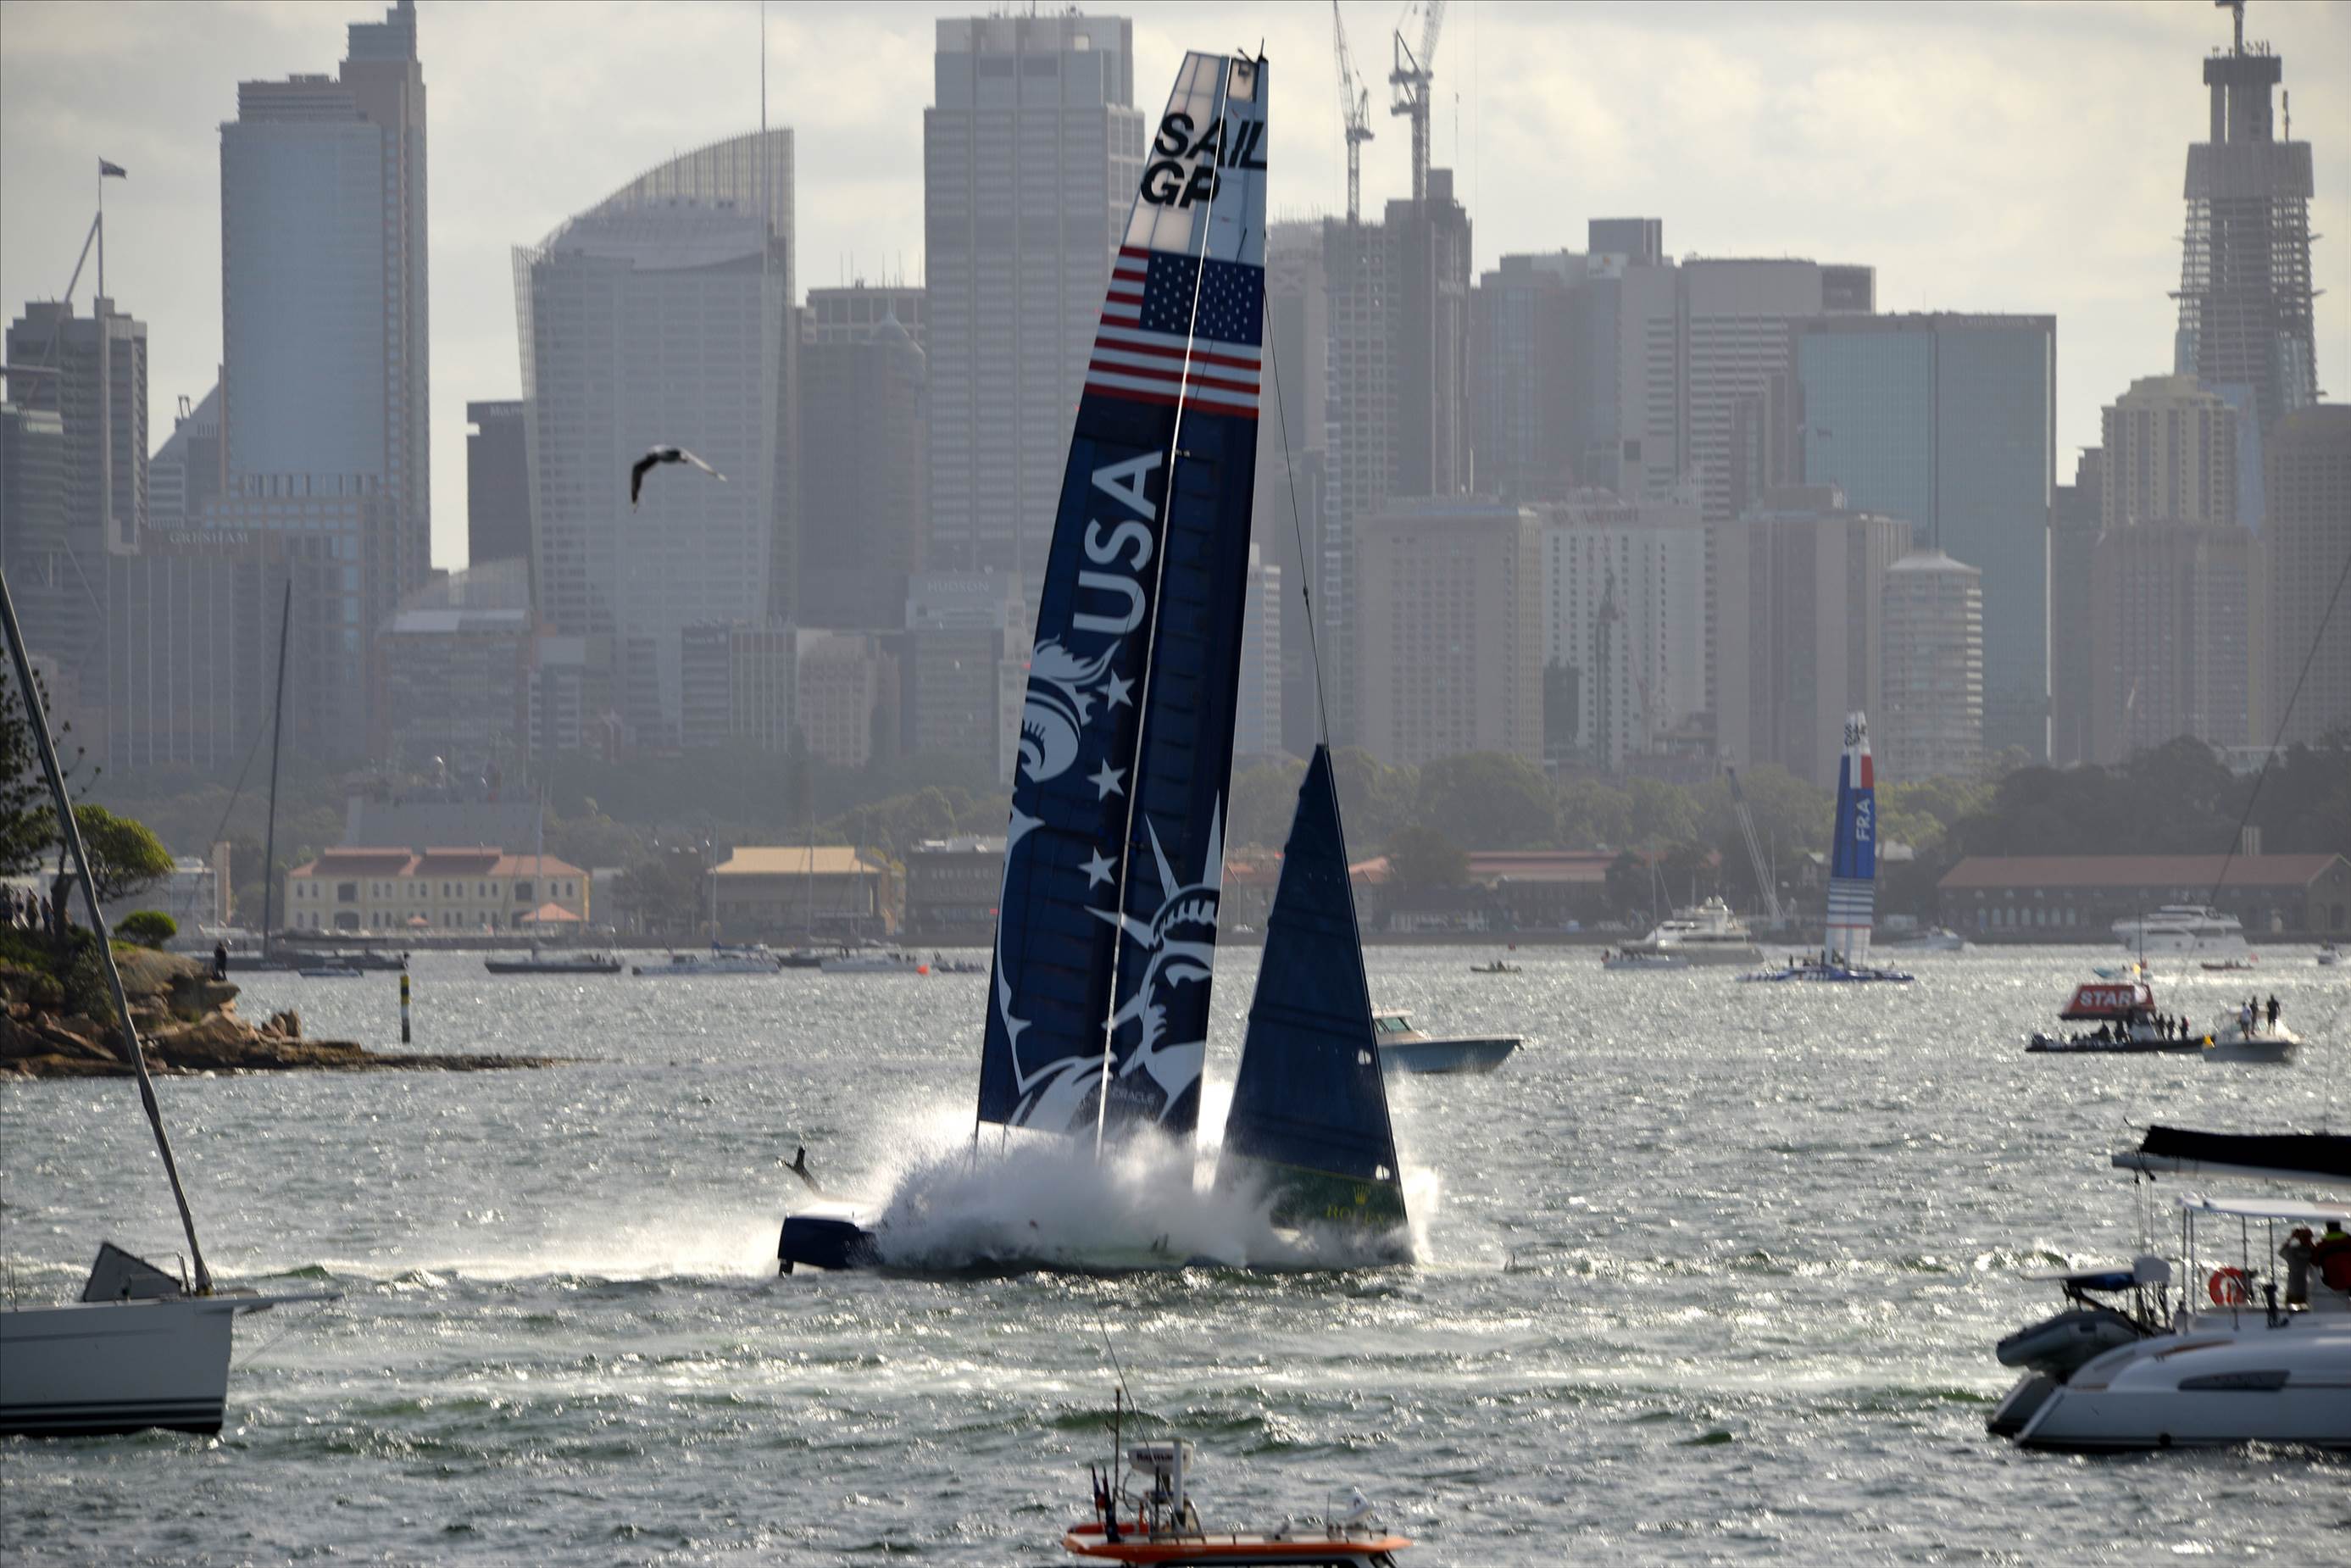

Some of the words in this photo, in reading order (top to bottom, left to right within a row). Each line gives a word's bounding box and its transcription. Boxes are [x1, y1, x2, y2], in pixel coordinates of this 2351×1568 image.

[1154, 112, 1268, 170] SAIL
[1141, 160, 1221, 209] GP
[1073, 451, 1162, 634] USA
[927, 581, 990, 593] HUDSON
[1855, 798, 1871, 842] FRA
[1137, 1451, 1187, 1464] Raymare
